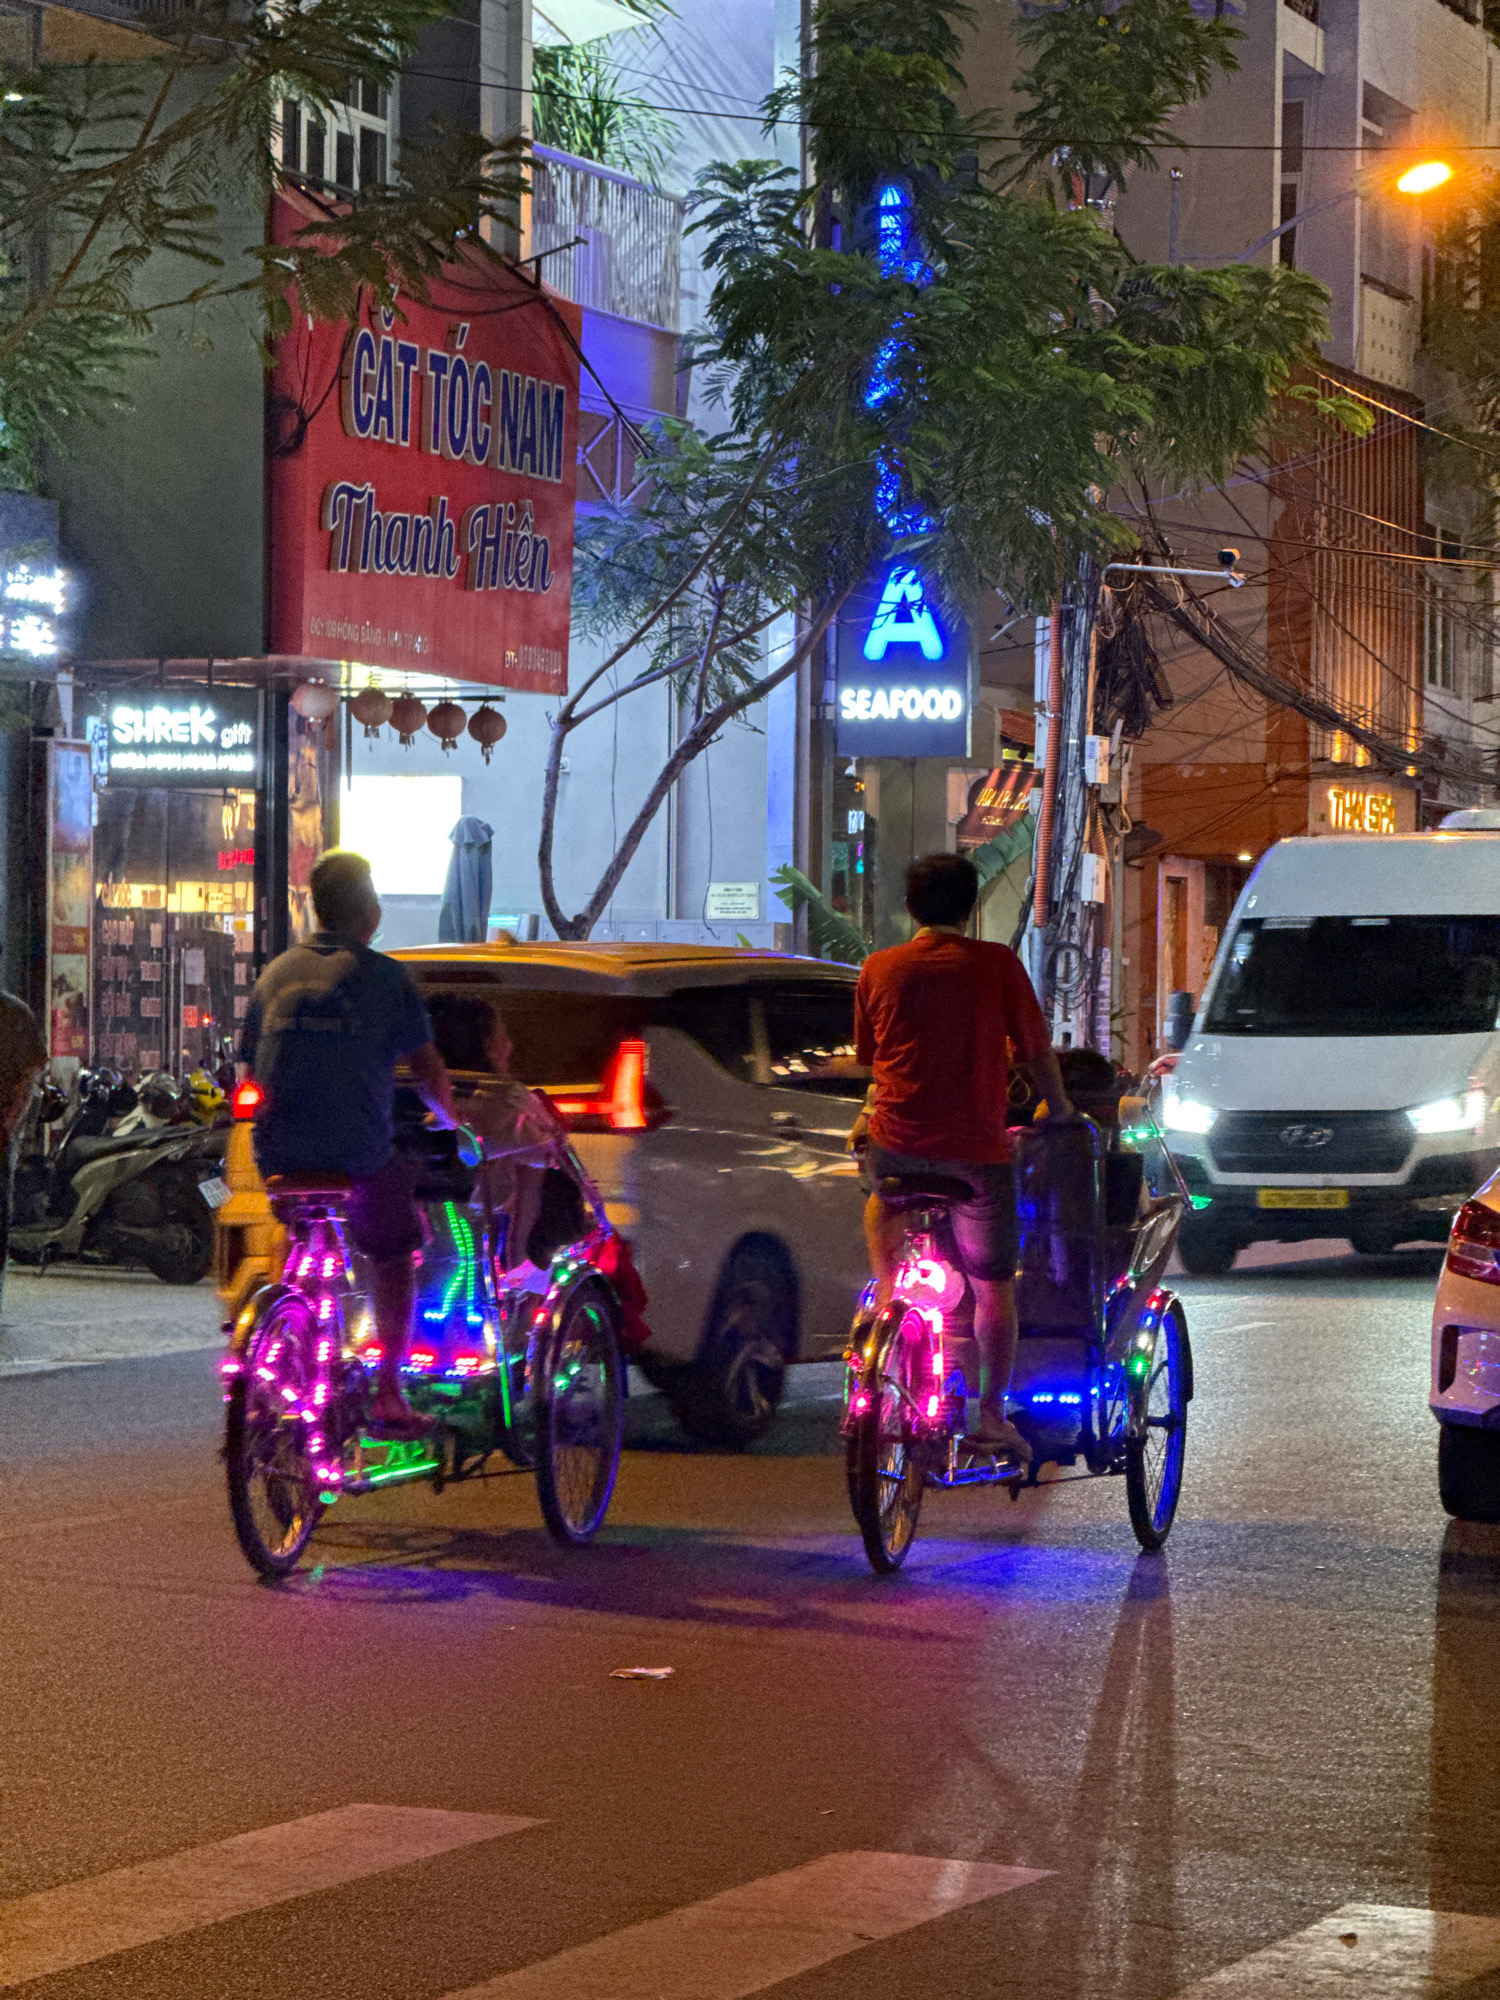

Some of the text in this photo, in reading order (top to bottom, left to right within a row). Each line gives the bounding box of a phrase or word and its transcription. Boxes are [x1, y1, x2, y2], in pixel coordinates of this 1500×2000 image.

[351, 283, 566, 484] CẮT TÓC NAM
[330, 481, 556, 594] Thanh Hiền
[112, 706, 252, 749] SHREK gift
[840, 688, 962, 720] SEAFOOD
